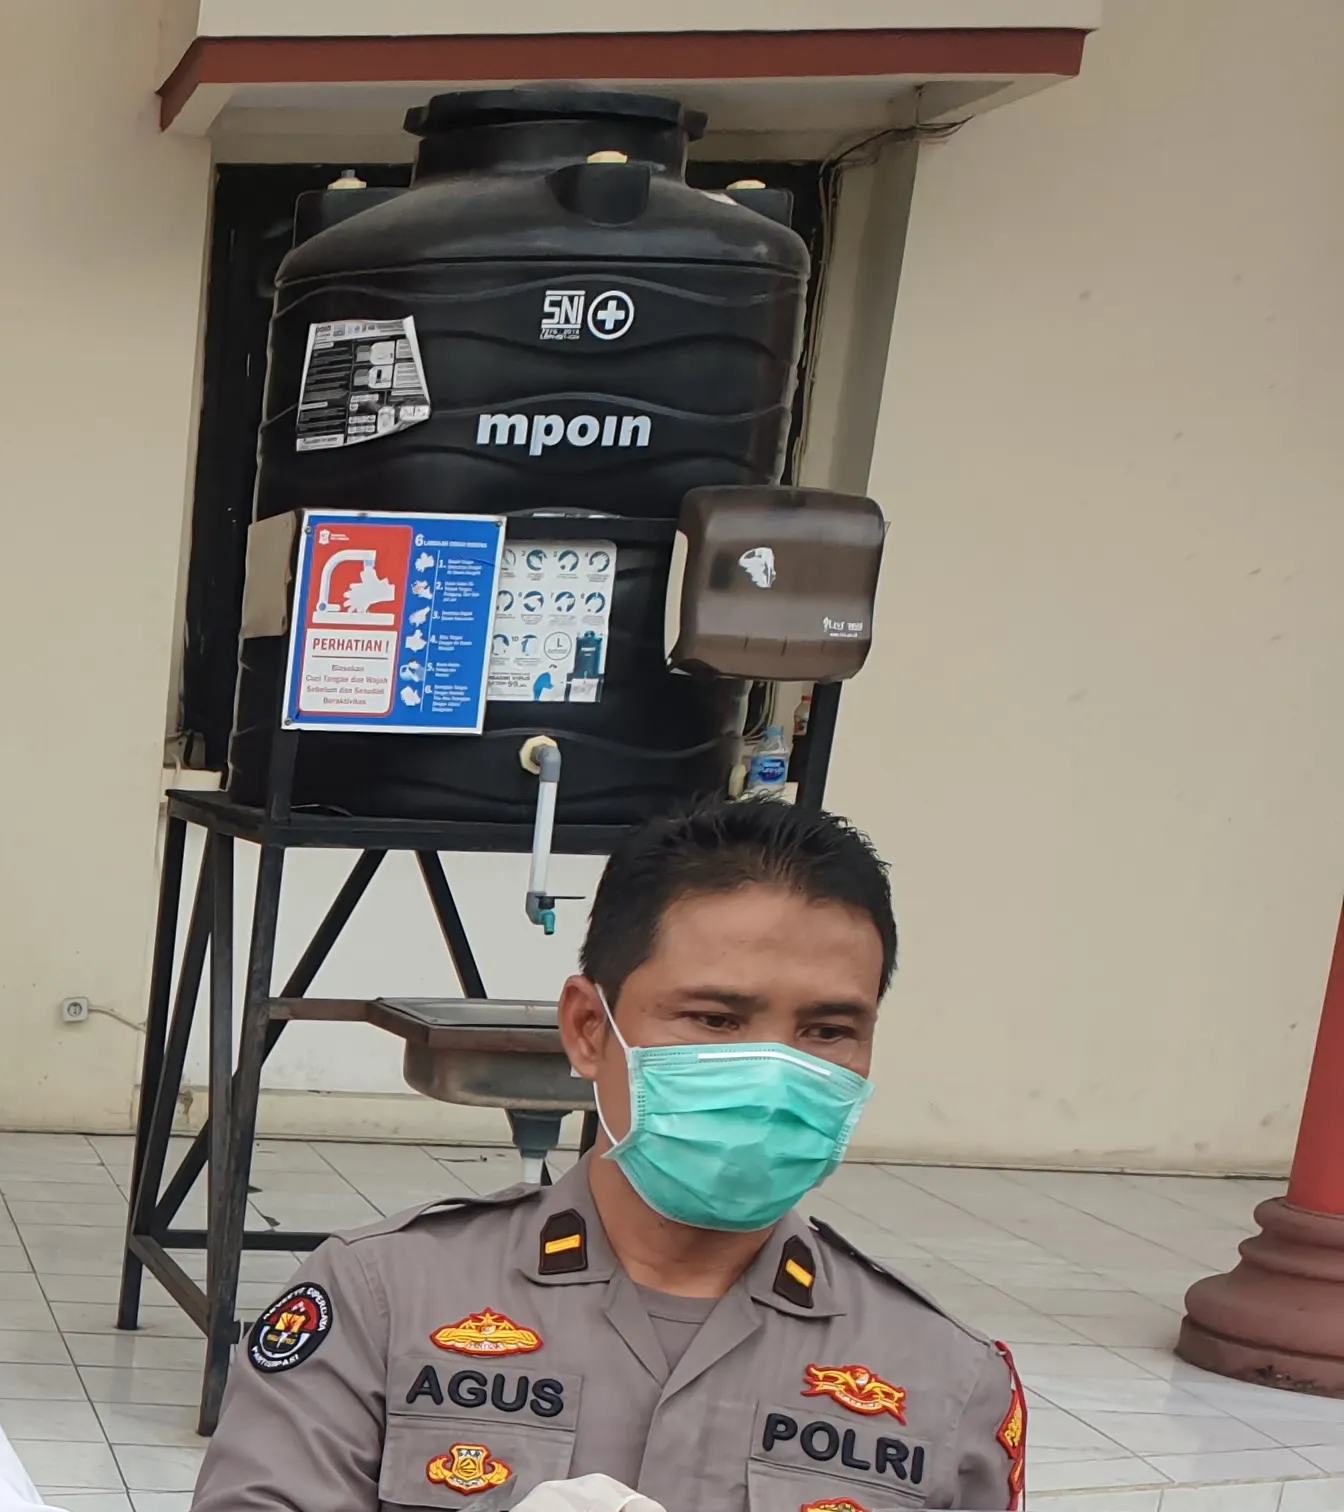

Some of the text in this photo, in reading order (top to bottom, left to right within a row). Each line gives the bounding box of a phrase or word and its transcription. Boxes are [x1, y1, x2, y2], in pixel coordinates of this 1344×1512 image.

[542, 293, 586, 326] SNI
[312, 637, 382, 652] PERHATIAN
[406, 1365, 564, 1418] AGUS
[762, 1413, 925, 1484] POLRI
